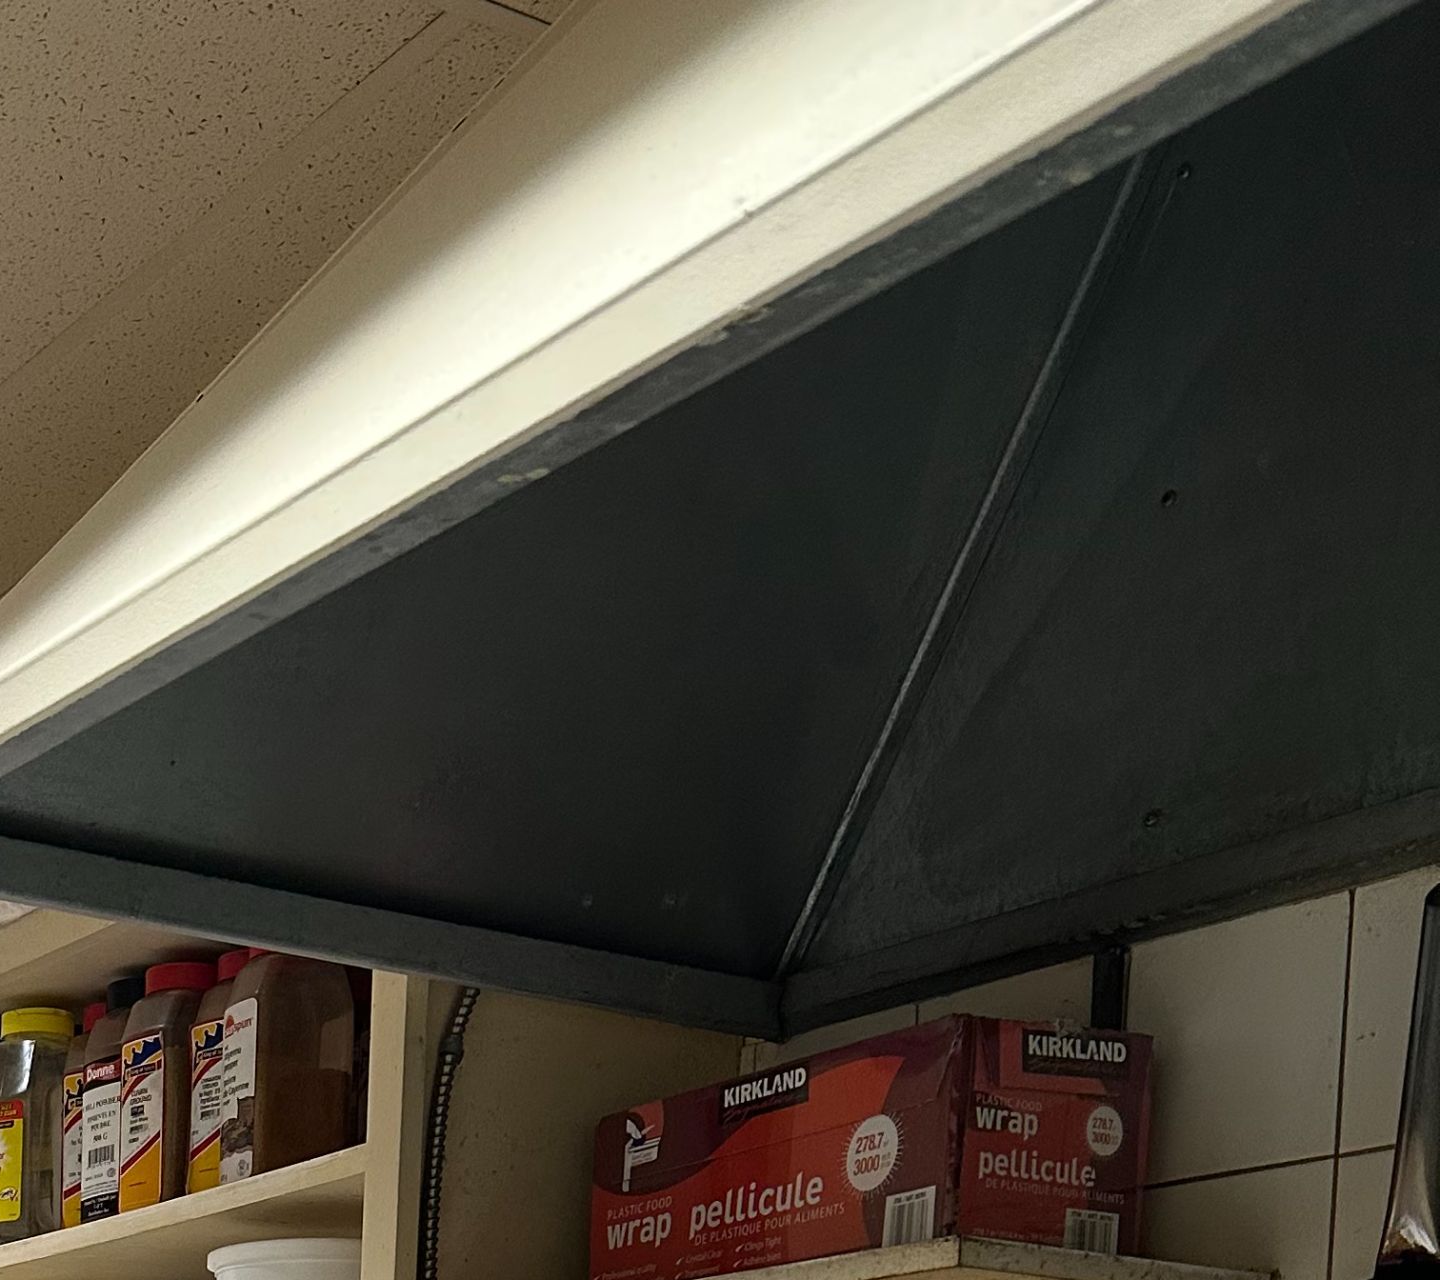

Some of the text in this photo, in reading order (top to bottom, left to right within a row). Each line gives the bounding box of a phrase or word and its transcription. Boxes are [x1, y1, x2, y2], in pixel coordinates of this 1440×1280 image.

[1028, 1034, 1127, 1063] KIRKLAND
[724, 1067, 807, 1108] KIRKLAND
[976, 1093, 1042, 1112] PLASTIC FOOD
[976, 1106, 1038, 1141] wrap
[855, 1131, 884, 1154] 278.7
[853, 1154, 880, 1176] 3000
[978, 1149, 1096, 1187] pellicule
[689, 1171, 823, 1240] pellicule
[986, 1177, 998, 1189] DE
[1000, 1179, 1049, 1196] PLASTIQUE
[1081, 1190, 1125, 1205] ALIMENTS
[607, 1196, 672, 1220] PLASTIC FOOD
[695, 1202, 846, 1246] DE PLASTIQUE POUR ALIMENTS
[607, 1211, 671, 1250] wrap
